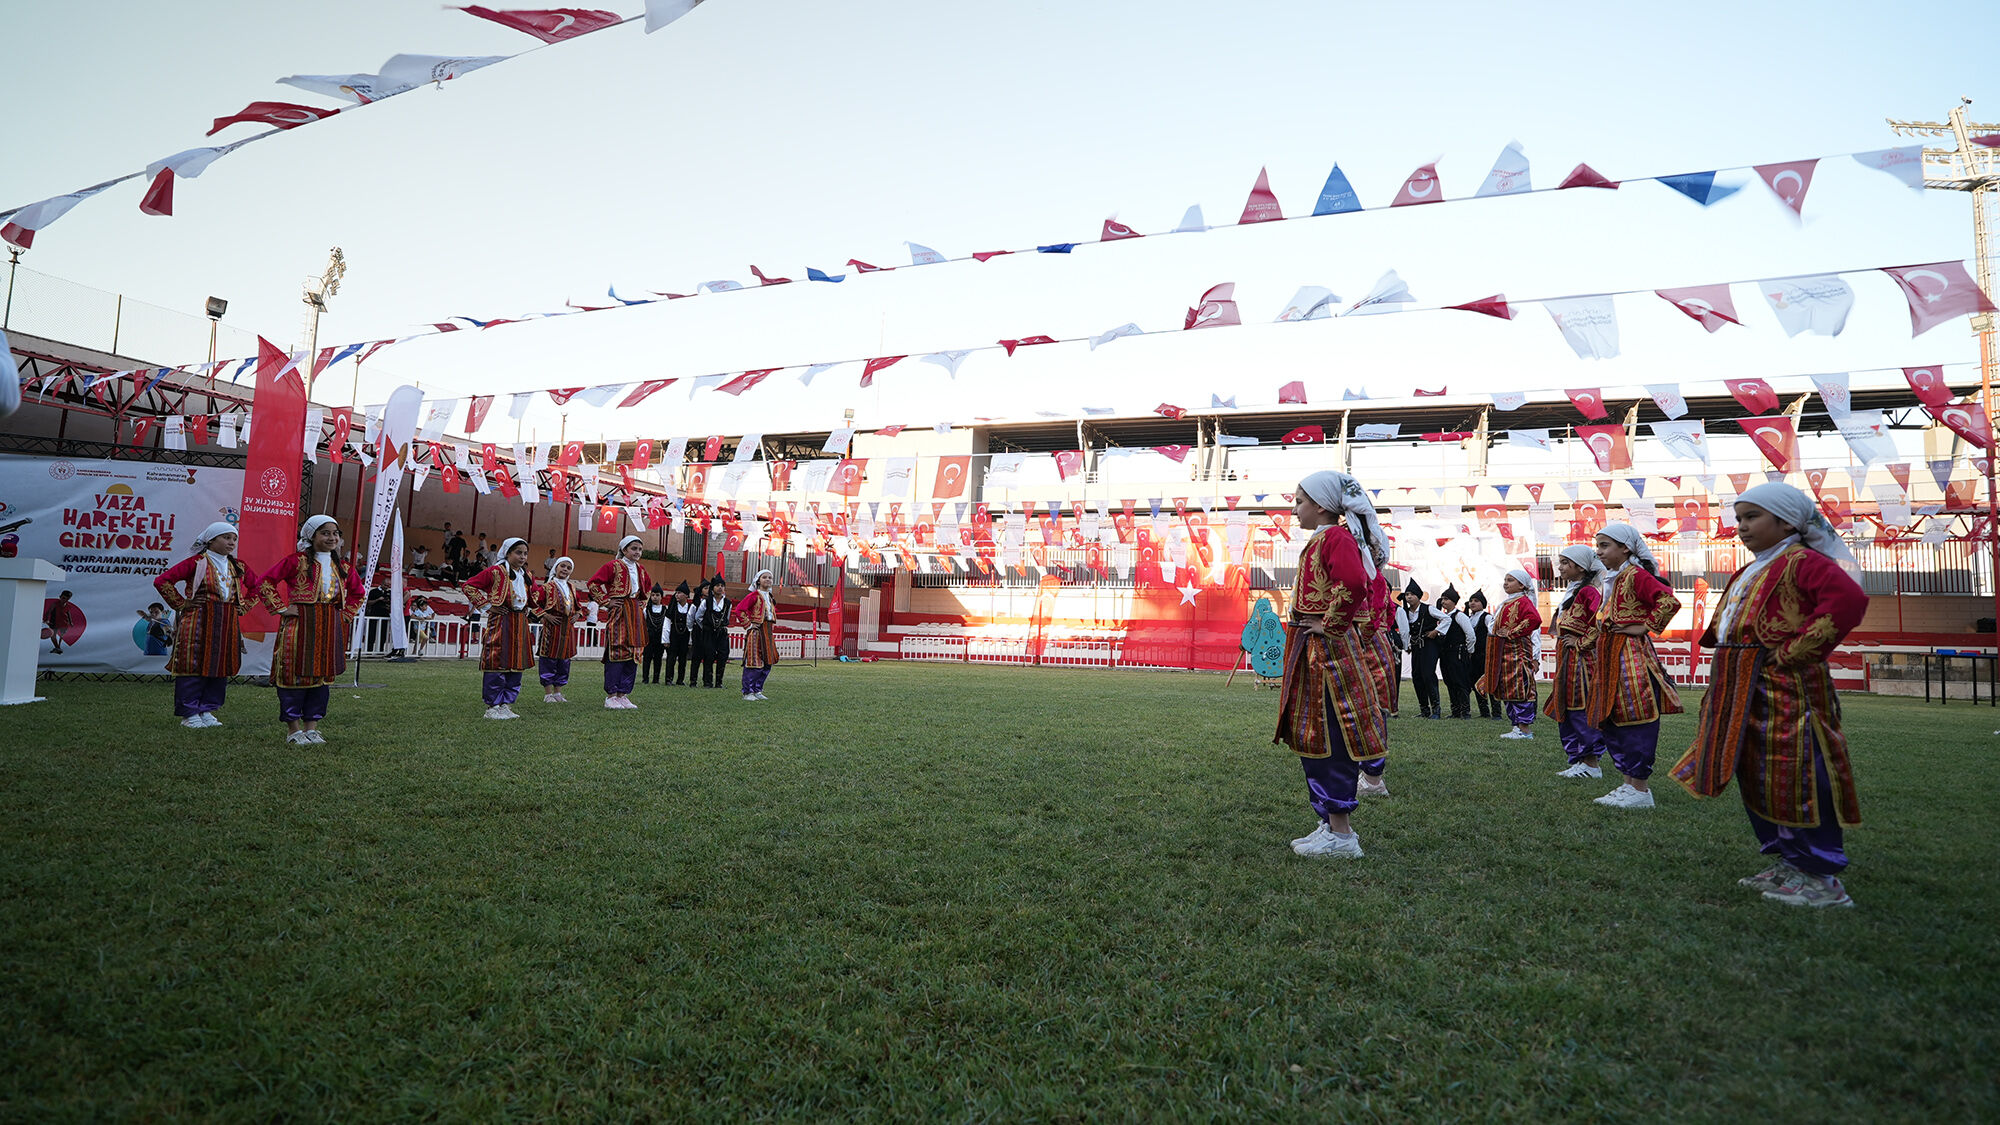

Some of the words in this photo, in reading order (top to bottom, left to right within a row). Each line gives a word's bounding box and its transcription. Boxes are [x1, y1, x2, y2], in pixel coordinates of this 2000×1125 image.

[94, 494, 145, 511] YAZA
[63, 508, 176, 537] HAREKETLİ
[59, 531, 174, 551] GİRİYORUZ
[63, 554, 169, 567] KAHRAMANMARAŞ
[75, 565, 133, 575] OKULLARI
